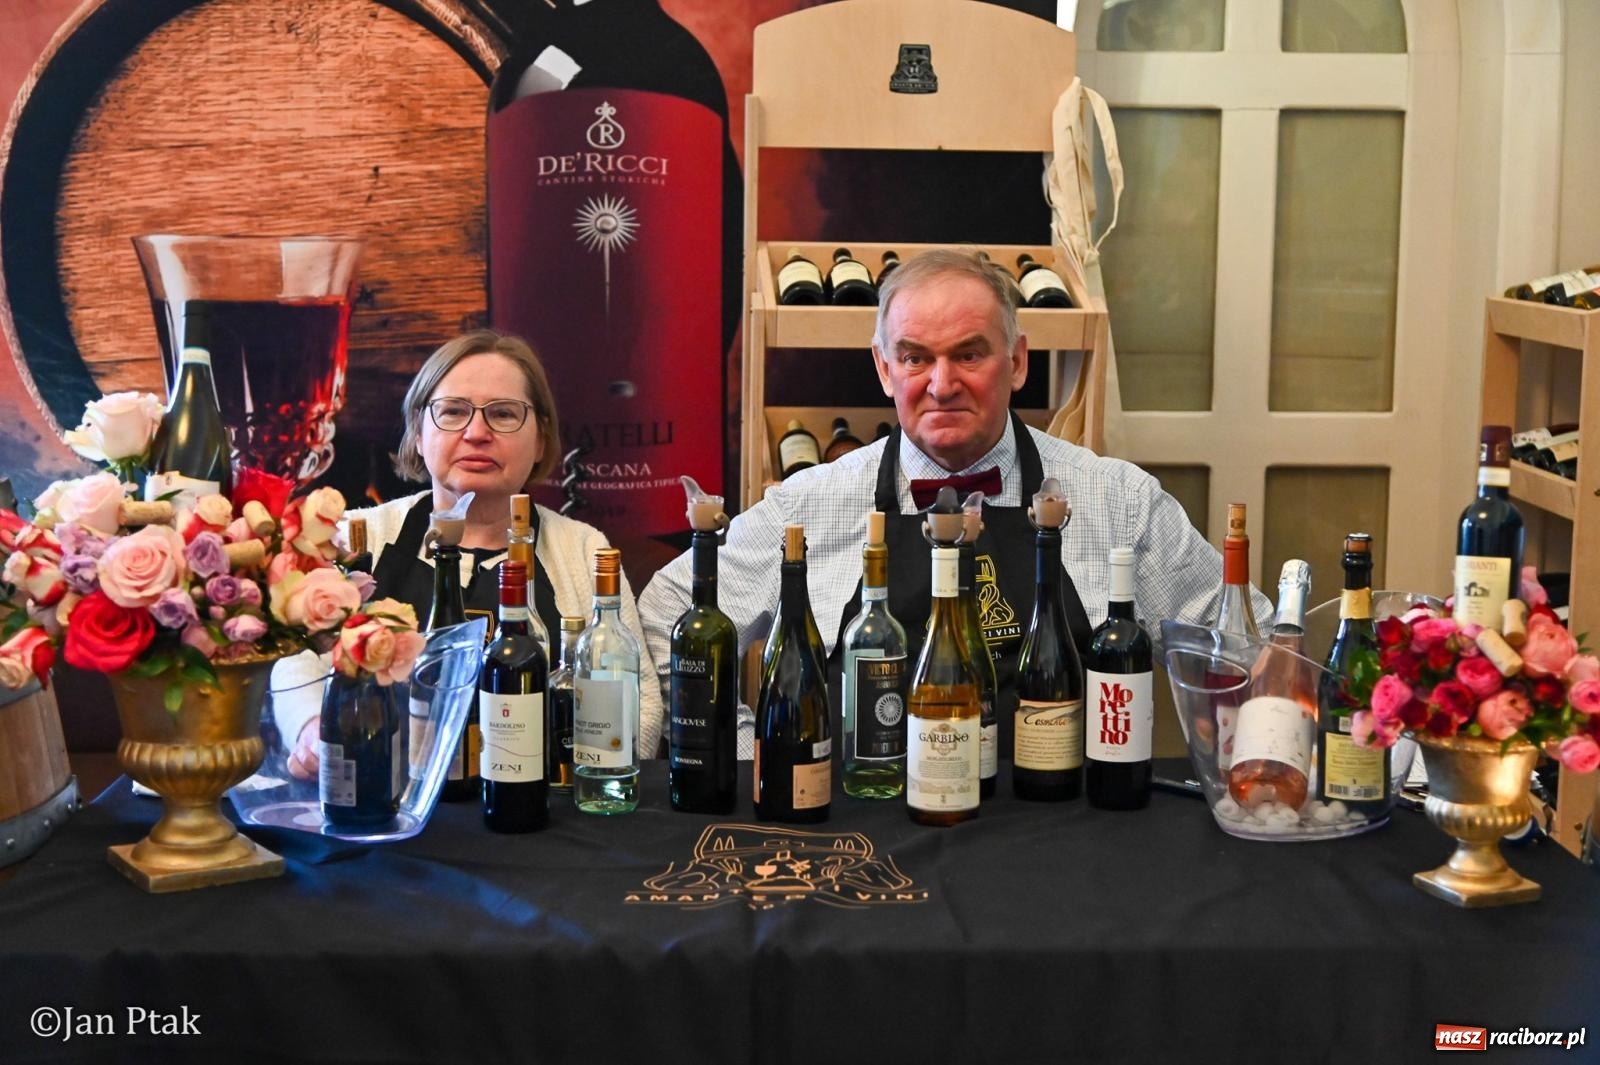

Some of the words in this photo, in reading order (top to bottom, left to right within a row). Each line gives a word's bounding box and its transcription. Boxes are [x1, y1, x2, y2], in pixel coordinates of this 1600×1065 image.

[537, 152, 669, 176] DE'RICCI
[589, 481, 652, 490] GEOGRAFICA
[996, 626, 1021, 636] VINI
[588, 721, 612, 729] GRIGIO
[918, 731, 970, 744] GARBINO
[491, 762, 522, 771] ZENI
